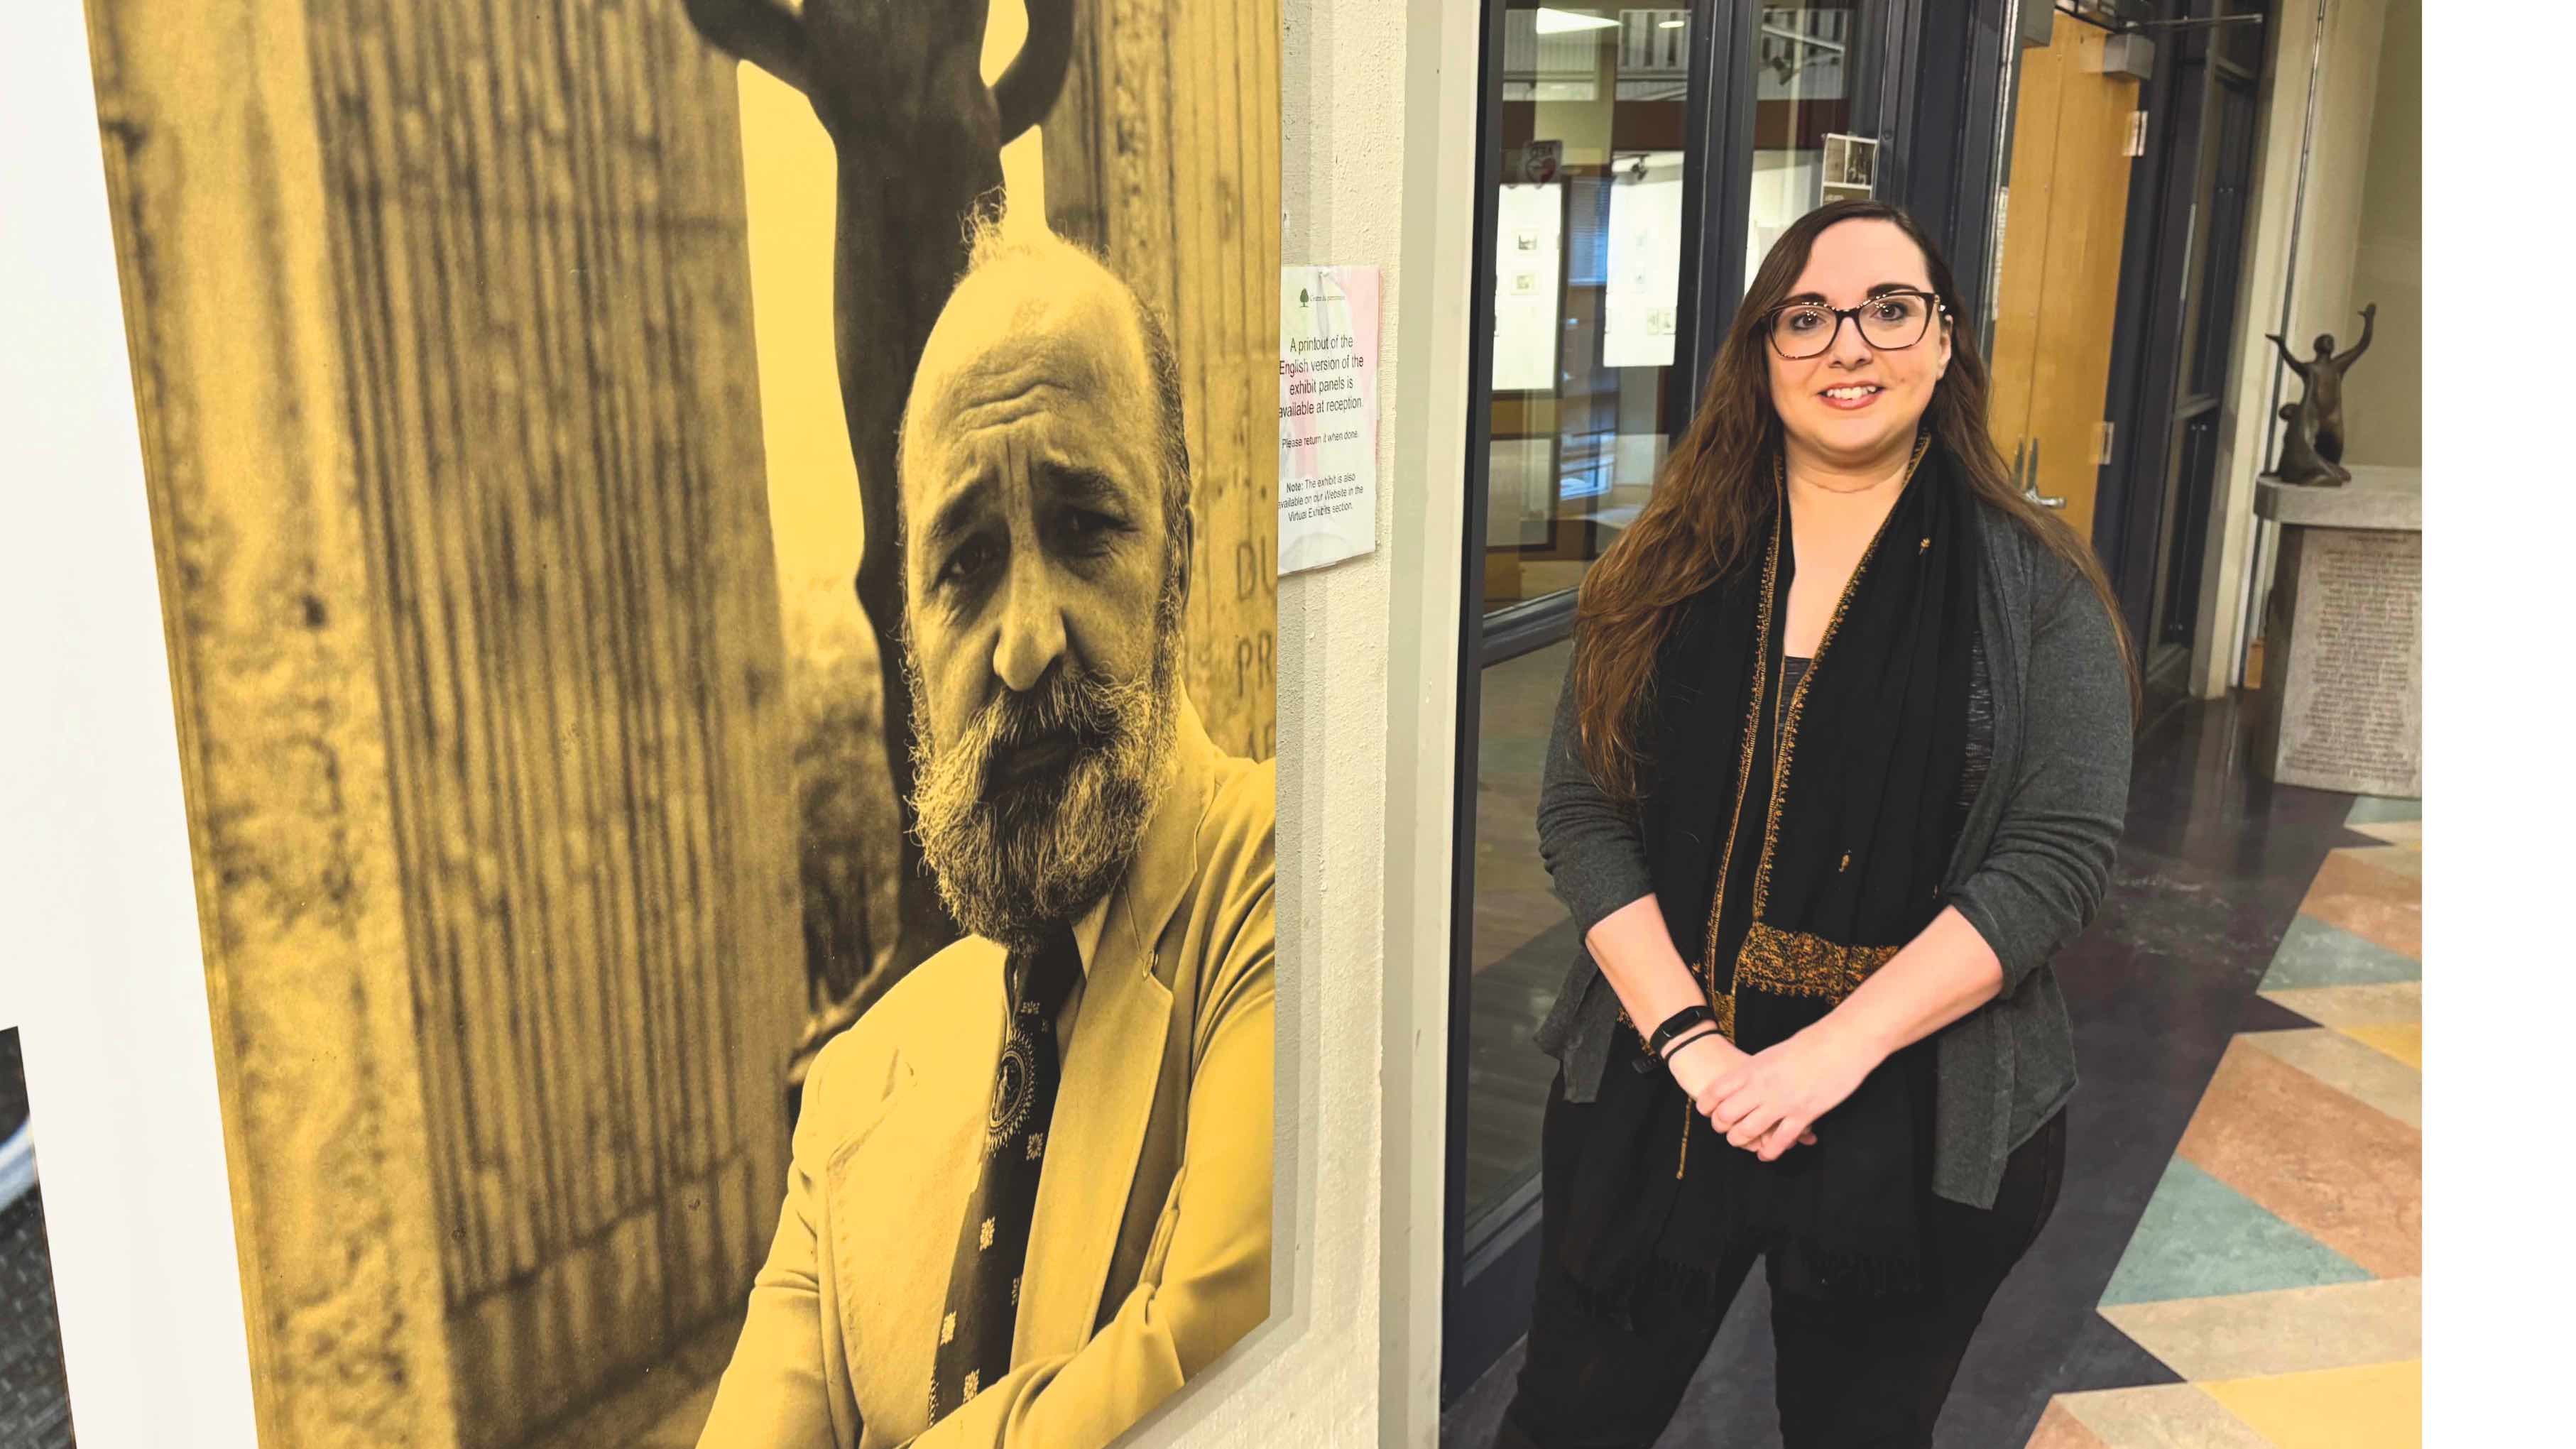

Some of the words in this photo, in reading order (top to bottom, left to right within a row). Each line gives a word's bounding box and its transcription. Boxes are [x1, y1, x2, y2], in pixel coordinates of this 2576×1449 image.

[1290, 337, 1297, 353] A
[1298, 337, 1328, 355] printout
[1331, 335, 1338, 349] of
[1341, 334, 1353, 349] the
[1279, 359, 1309, 378] English
[1311, 356, 1340, 372] version
[1341, 354, 1350, 369] of
[1352, 353, 1364, 368] the
[1289, 379, 1316, 395] exhibit
[1319, 376, 1345, 395] panels
[1347, 375, 1353, 389] is
[1279, 400, 1314, 418] available
[1316, 399, 1324, 413] at
[1282, 437, 1303, 449] Please
[1304, 434, 1321, 446] return
[1328, 430, 1343, 442] when
[1287, 482, 1304, 493] Note:
[1305, 479, 1316, 489] The
[1317, 475, 1336, 488] exhibit
[1344, 472, 1356, 483] also
[1304, 493, 1312, 505] on
[1324, 488, 1347, 501] Website
[1355, 484, 1364, 495] the
[1288, 509, 1307, 523] Virtual
[1309, 504, 1331, 518] Exhibits
